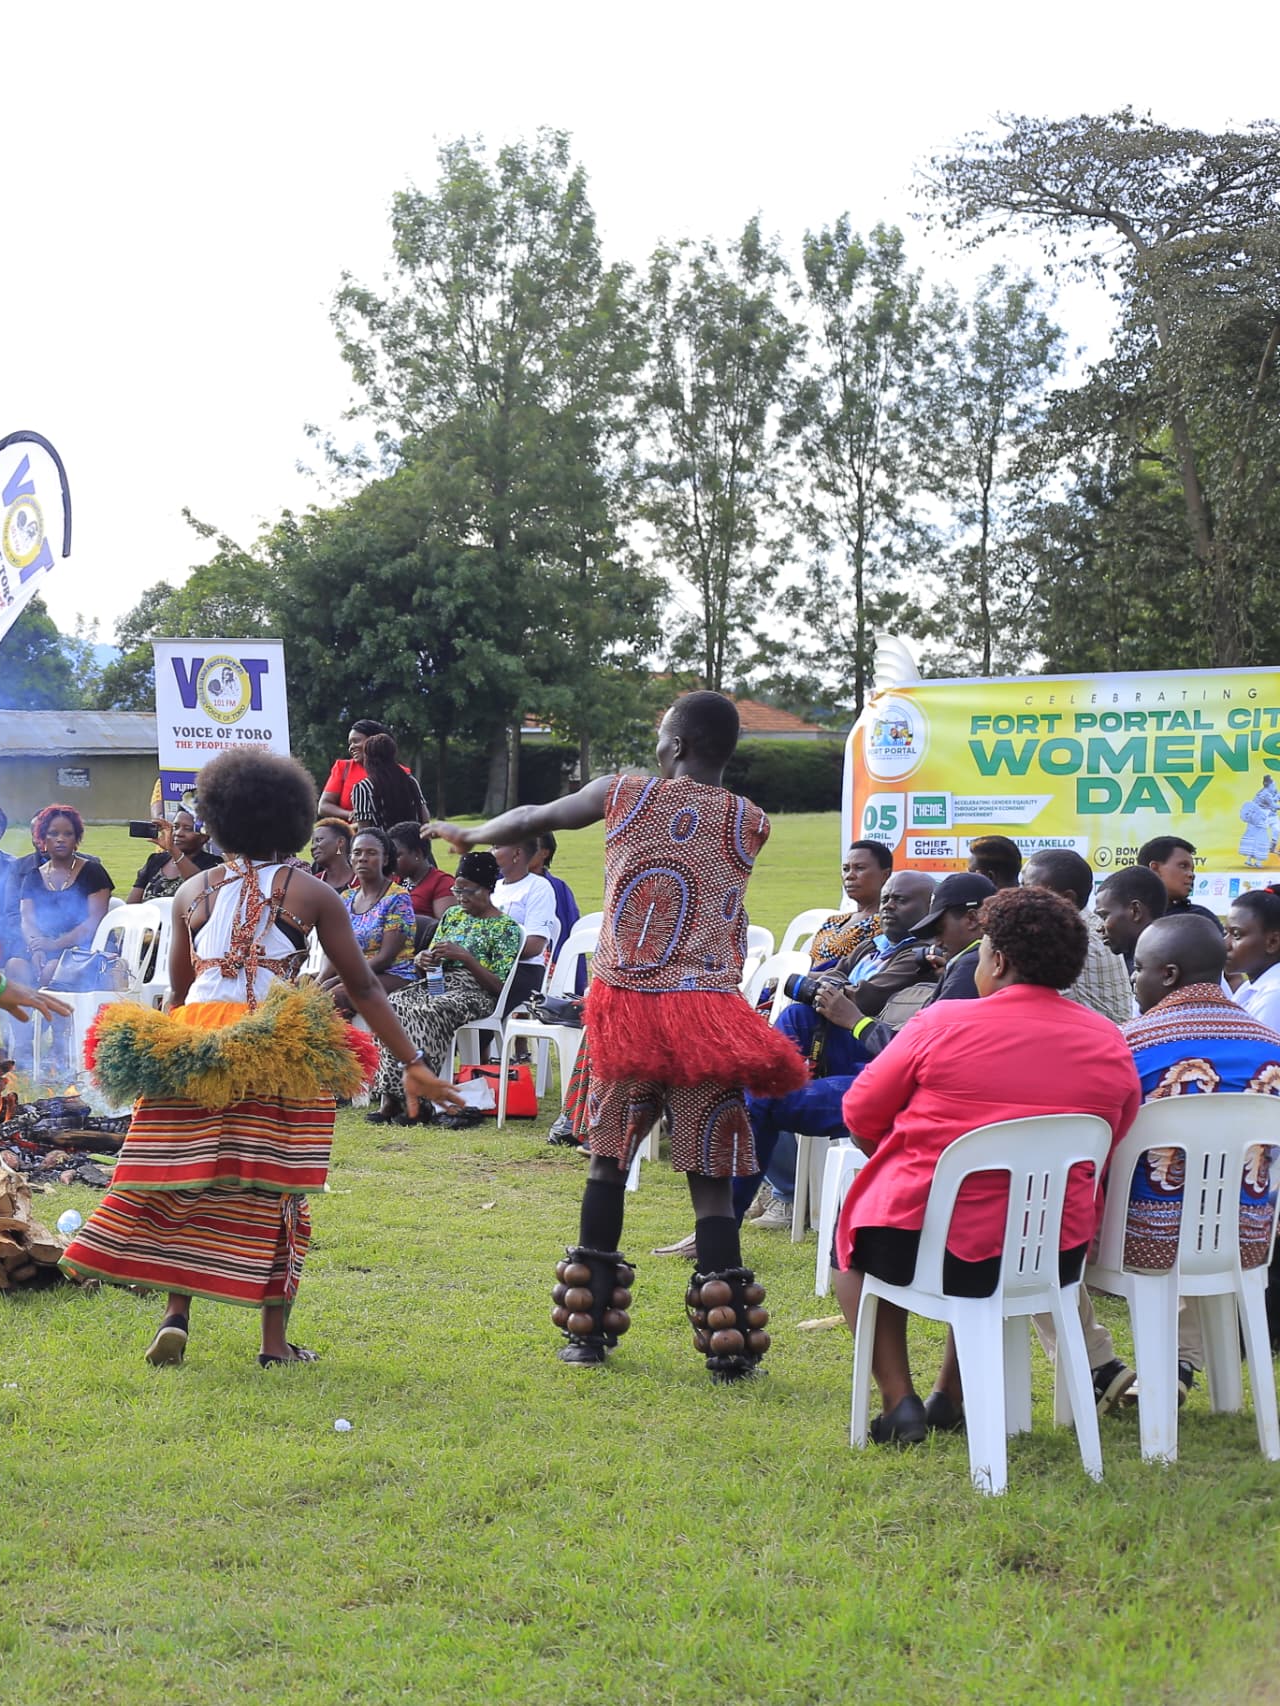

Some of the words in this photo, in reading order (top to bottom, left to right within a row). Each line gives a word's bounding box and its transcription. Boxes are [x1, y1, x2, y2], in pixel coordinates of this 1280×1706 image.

[171, 655, 269, 718] VOT
[1024, 688, 1258, 706] CELEBRATING
[970, 713, 1062, 735] FORT
[1074, 710, 1214, 733] PORTAL
[1227, 707, 1280, 730] CIT
[172, 726, 213, 738] VOICE
[216, 727, 233, 739] OF
[235, 728, 273, 740] TORO
[175, 740, 193, 749] THE
[195, 741, 238, 750] PEOPLE'S
[968, 730, 1280, 776] WOMEN'S
[1076, 775, 1215, 815] DAY
[913, 803, 946, 817] THEME:
[863, 805, 898, 831] 05
[914, 840, 948, 848] CHIEF
[1016, 839, 1036, 848] ILLY
[1039, 839, 1076, 848] AKELLO
[914, 848, 954, 856] GUEST:
[1115, 847, 1139, 856] BOM
[1115, 857, 1136, 866] FOR
